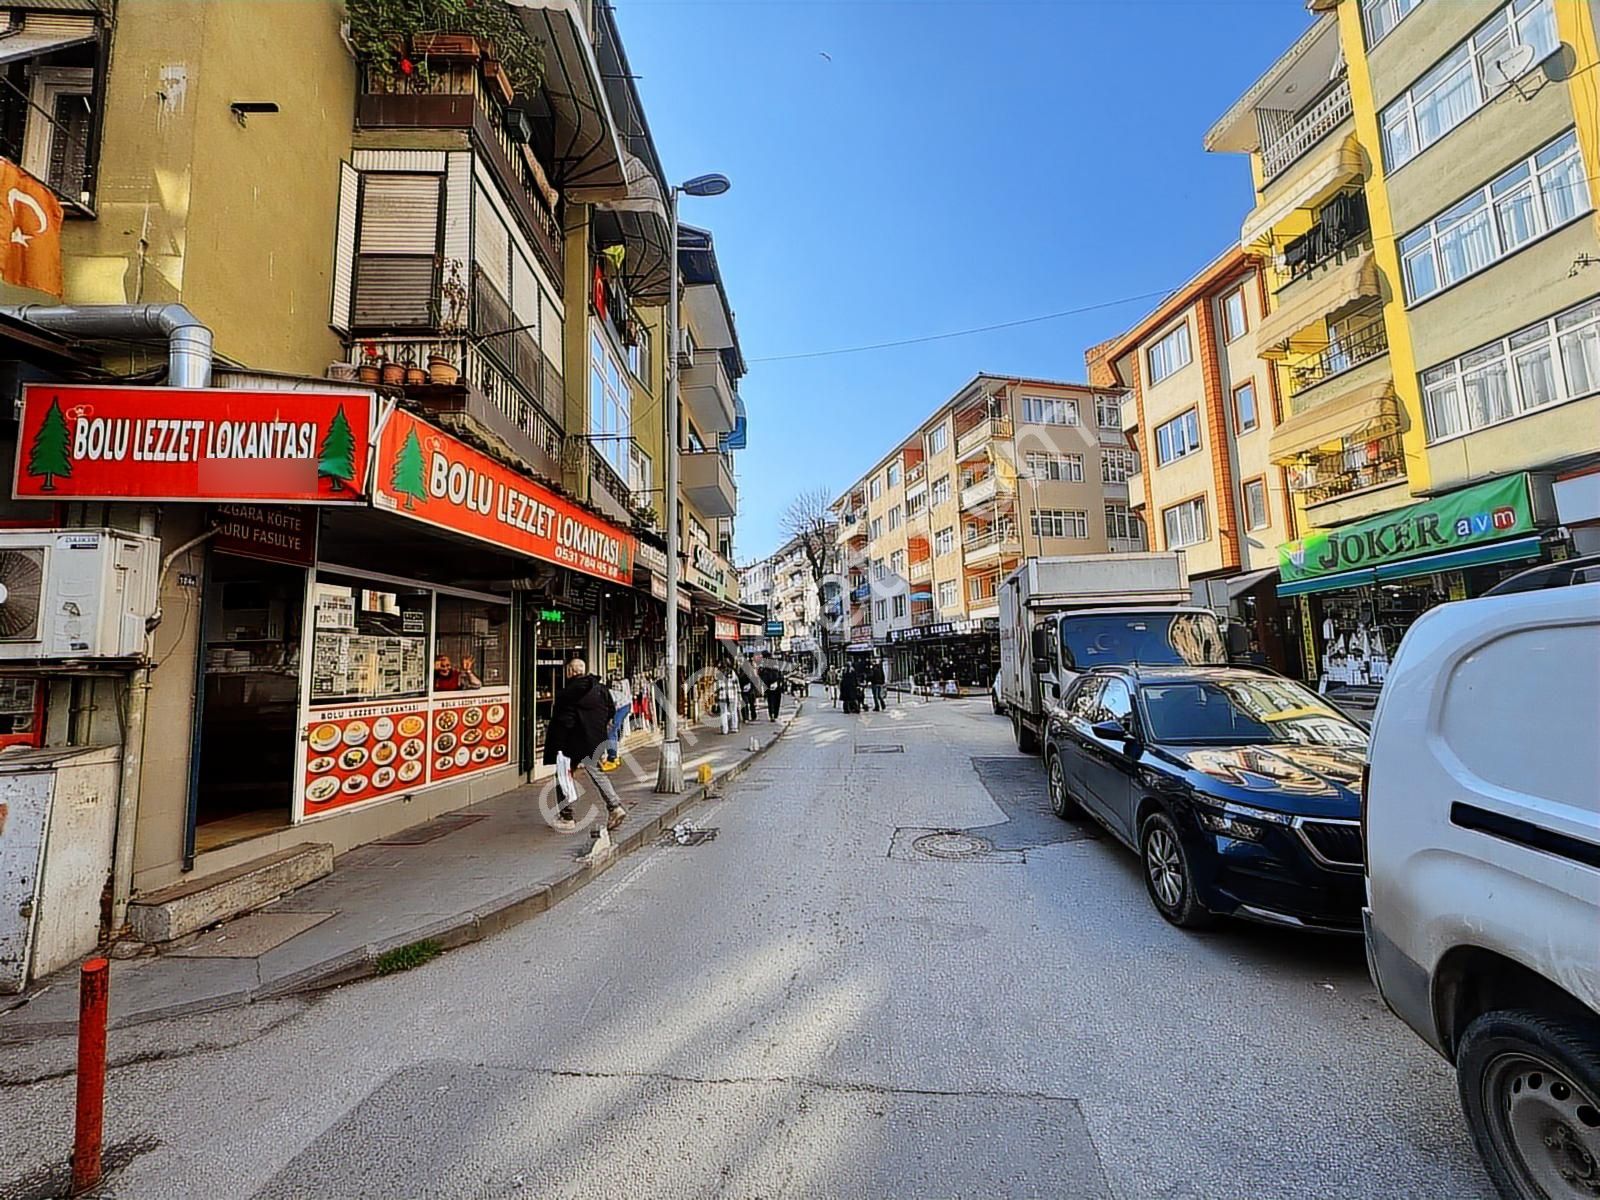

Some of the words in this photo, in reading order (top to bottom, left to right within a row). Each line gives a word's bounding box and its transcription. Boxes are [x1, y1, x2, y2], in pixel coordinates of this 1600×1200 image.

[73, 416, 130, 460] BOLU
[133, 419, 204, 462] LEZZET
[206, 422, 317, 459] LOKANTASI
[430, 451, 493, 515] BOLU
[496, 482, 555, 540] LEZZET
[557, 512, 619, 565] LOKANTASI
[253, 528, 301, 550] FASULYE
[555, 546, 578, 562] 0531
[1319, 512, 1448, 569] JOKER
[1456, 510, 1515, 537] avm
[321, 711, 344, 720] BOLU
[349, 708, 376, 718] LEZZET
[381, 704, 419, 714] LOKANTASI
